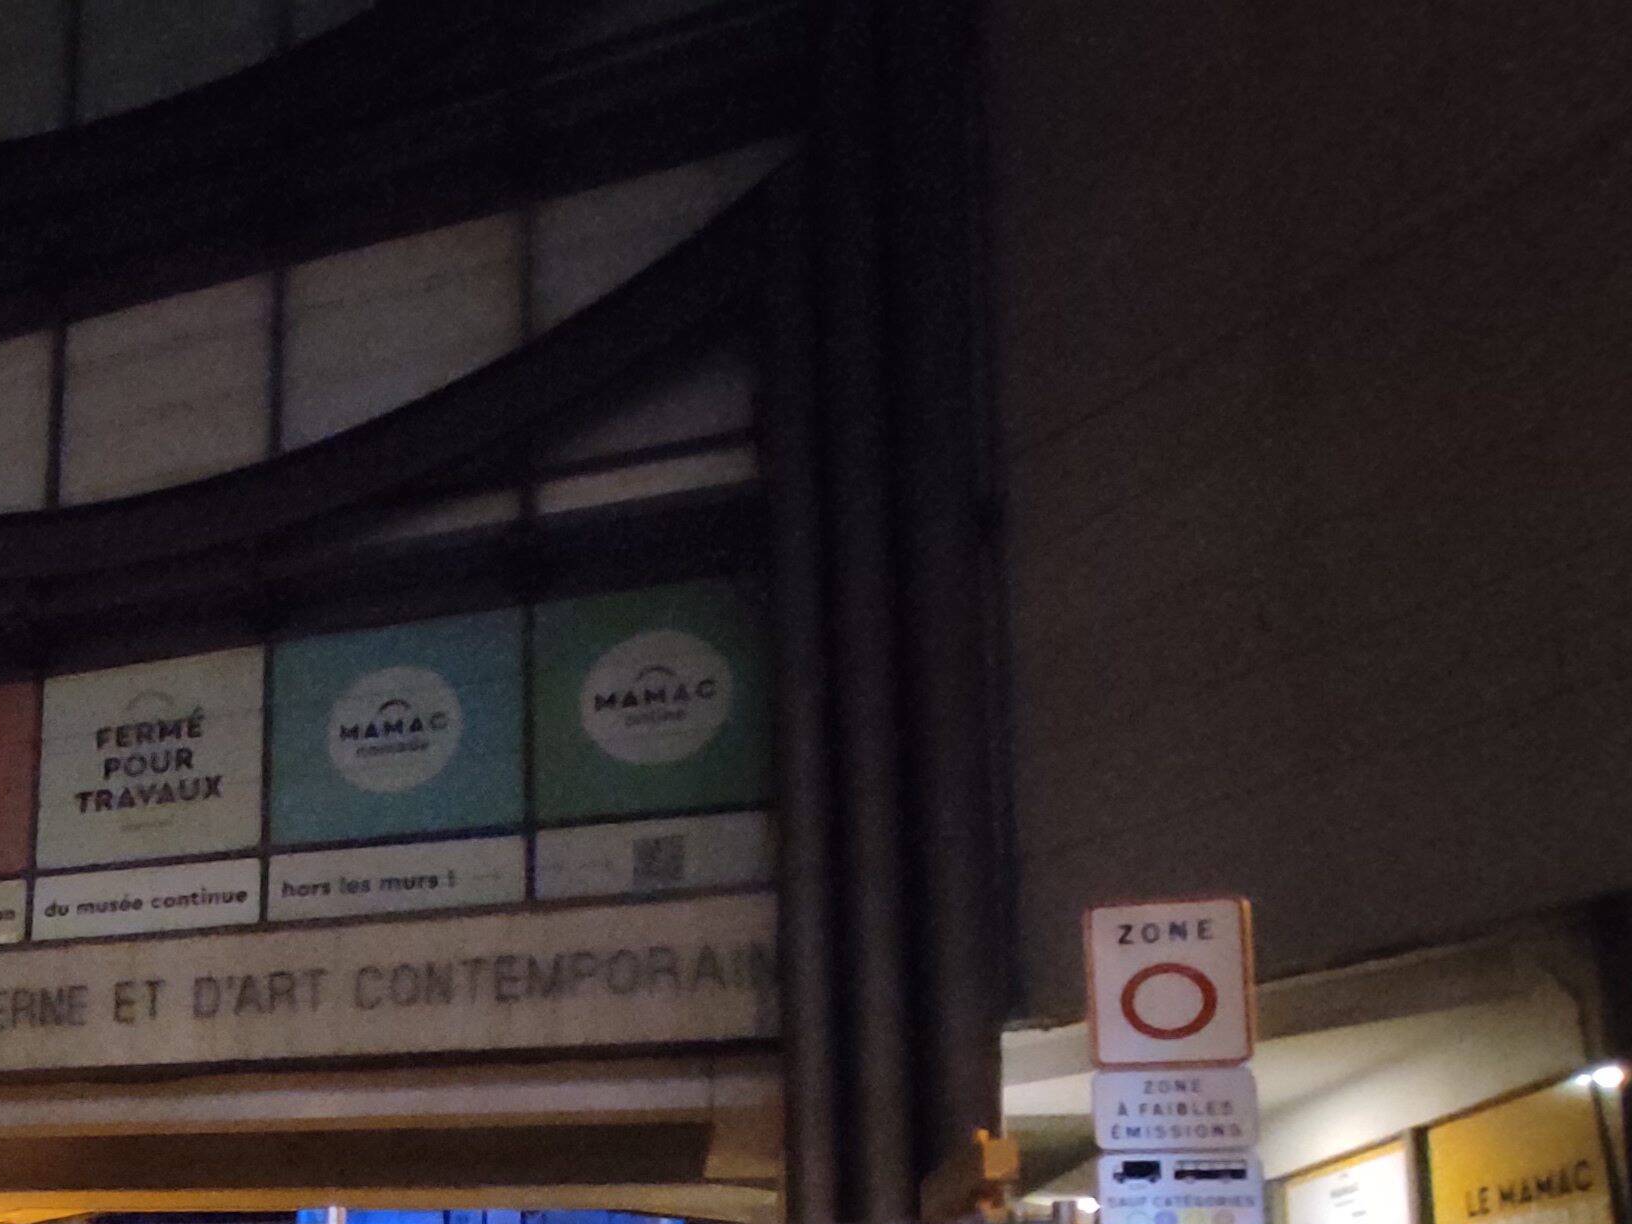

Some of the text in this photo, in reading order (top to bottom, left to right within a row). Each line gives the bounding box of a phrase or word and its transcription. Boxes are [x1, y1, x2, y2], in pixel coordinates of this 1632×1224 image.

[594, 678, 716, 712] MAMAC
[96, 707, 205, 749] FERMÉ
[340, 712, 447, 741] MAMAC
[103, 748, 194, 779] POUR
[75, 775, 223, 813] TRAVAUX
[45, 899, 69, 918] du
[77, 893, 143, 914] musée
[151, 887, 248, 909] continue
[282, 880, 331, 897] hors
[340, 876, 370, 893] les
[379, 873, 438, 890] murs
[1117, 918, 1213, 945] ZONE
[113, 978, 164, 1024] ET
[193, 967, 326, 1019] D'ART
[1144, 1078, 1202, 1095] ZONE
[1138, 1100, 1234, 1117] FAIBLES
[1466, 1158, 1594, 1217] LE MAMAC
